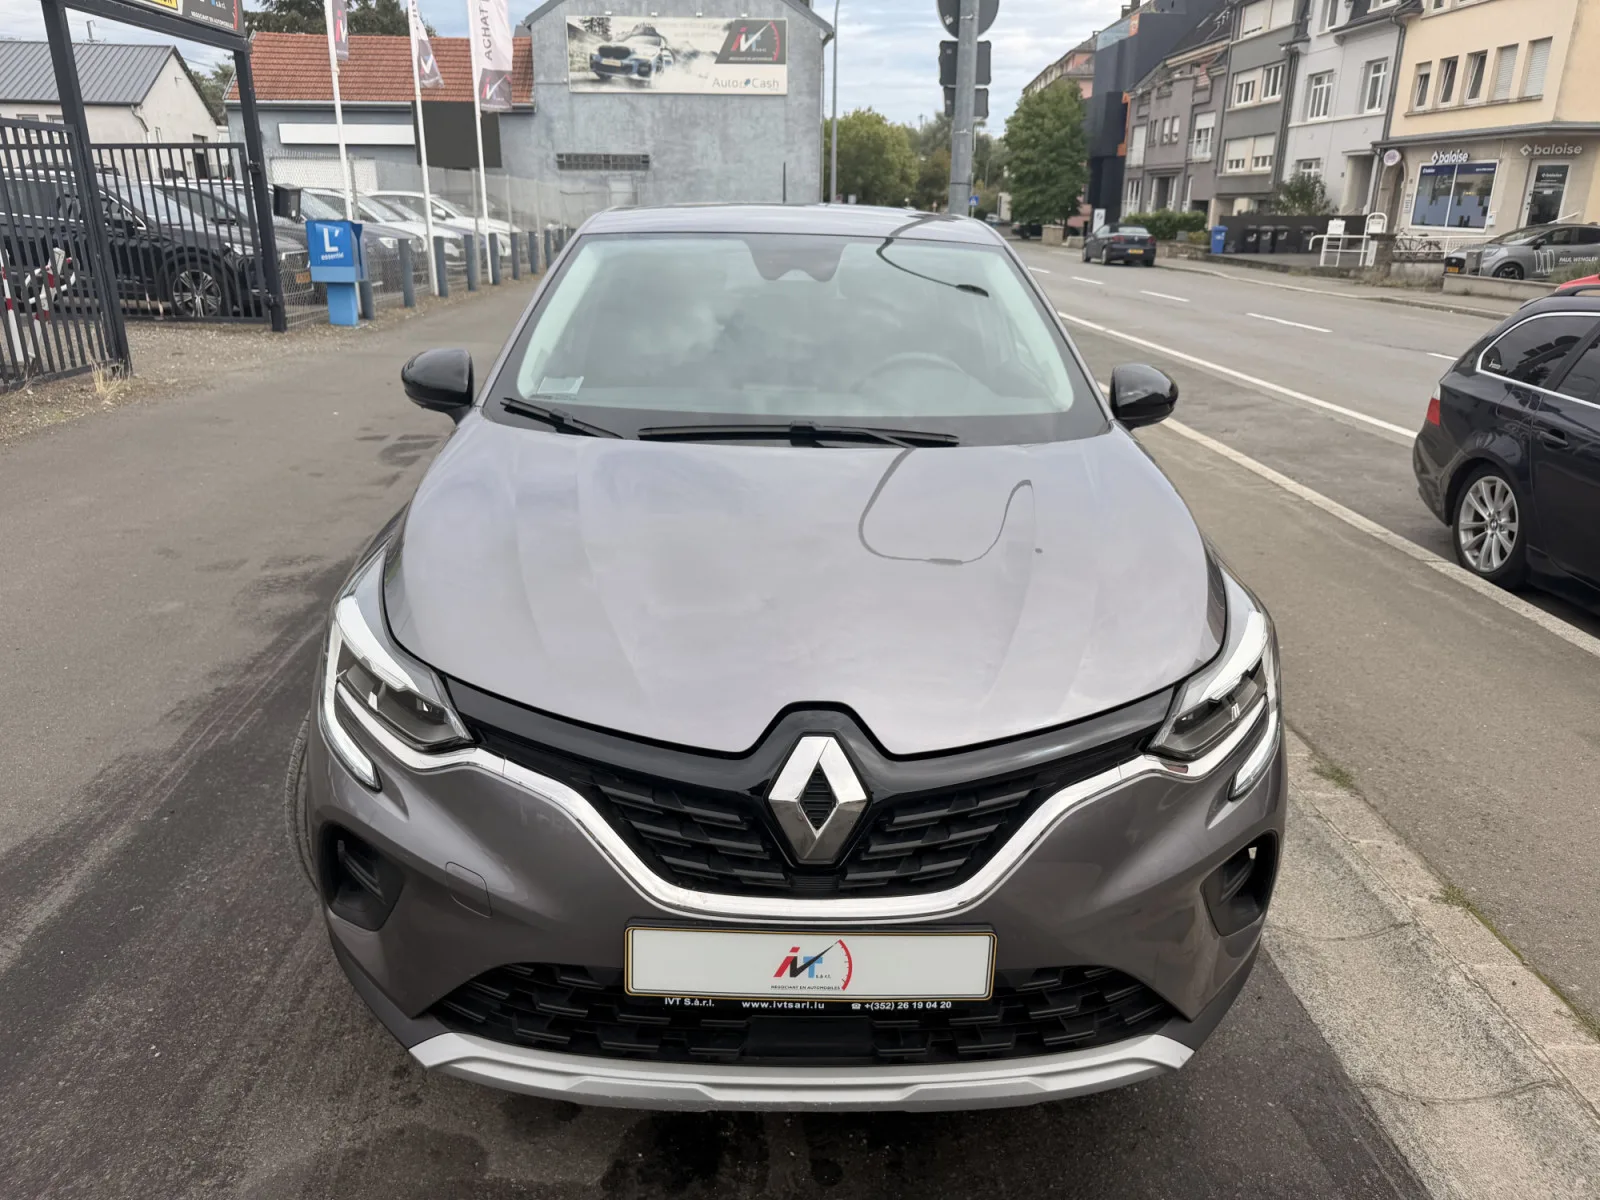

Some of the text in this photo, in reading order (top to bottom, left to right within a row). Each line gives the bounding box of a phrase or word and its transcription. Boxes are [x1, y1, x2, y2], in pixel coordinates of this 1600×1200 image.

[479, 5, 493, 61] ACHAT
[712, 77, 780, 89] Auto Cash
[1533, 143, 1583, 156] baloise
[1439, 149, 1468, 164] baloise
[664, 997, 682, 1006] IVT
[741, 1001, 825, 1010] www.ivtsarl.lu
[864, 1001, 952, 1011] +(352) 26 19 04 20
